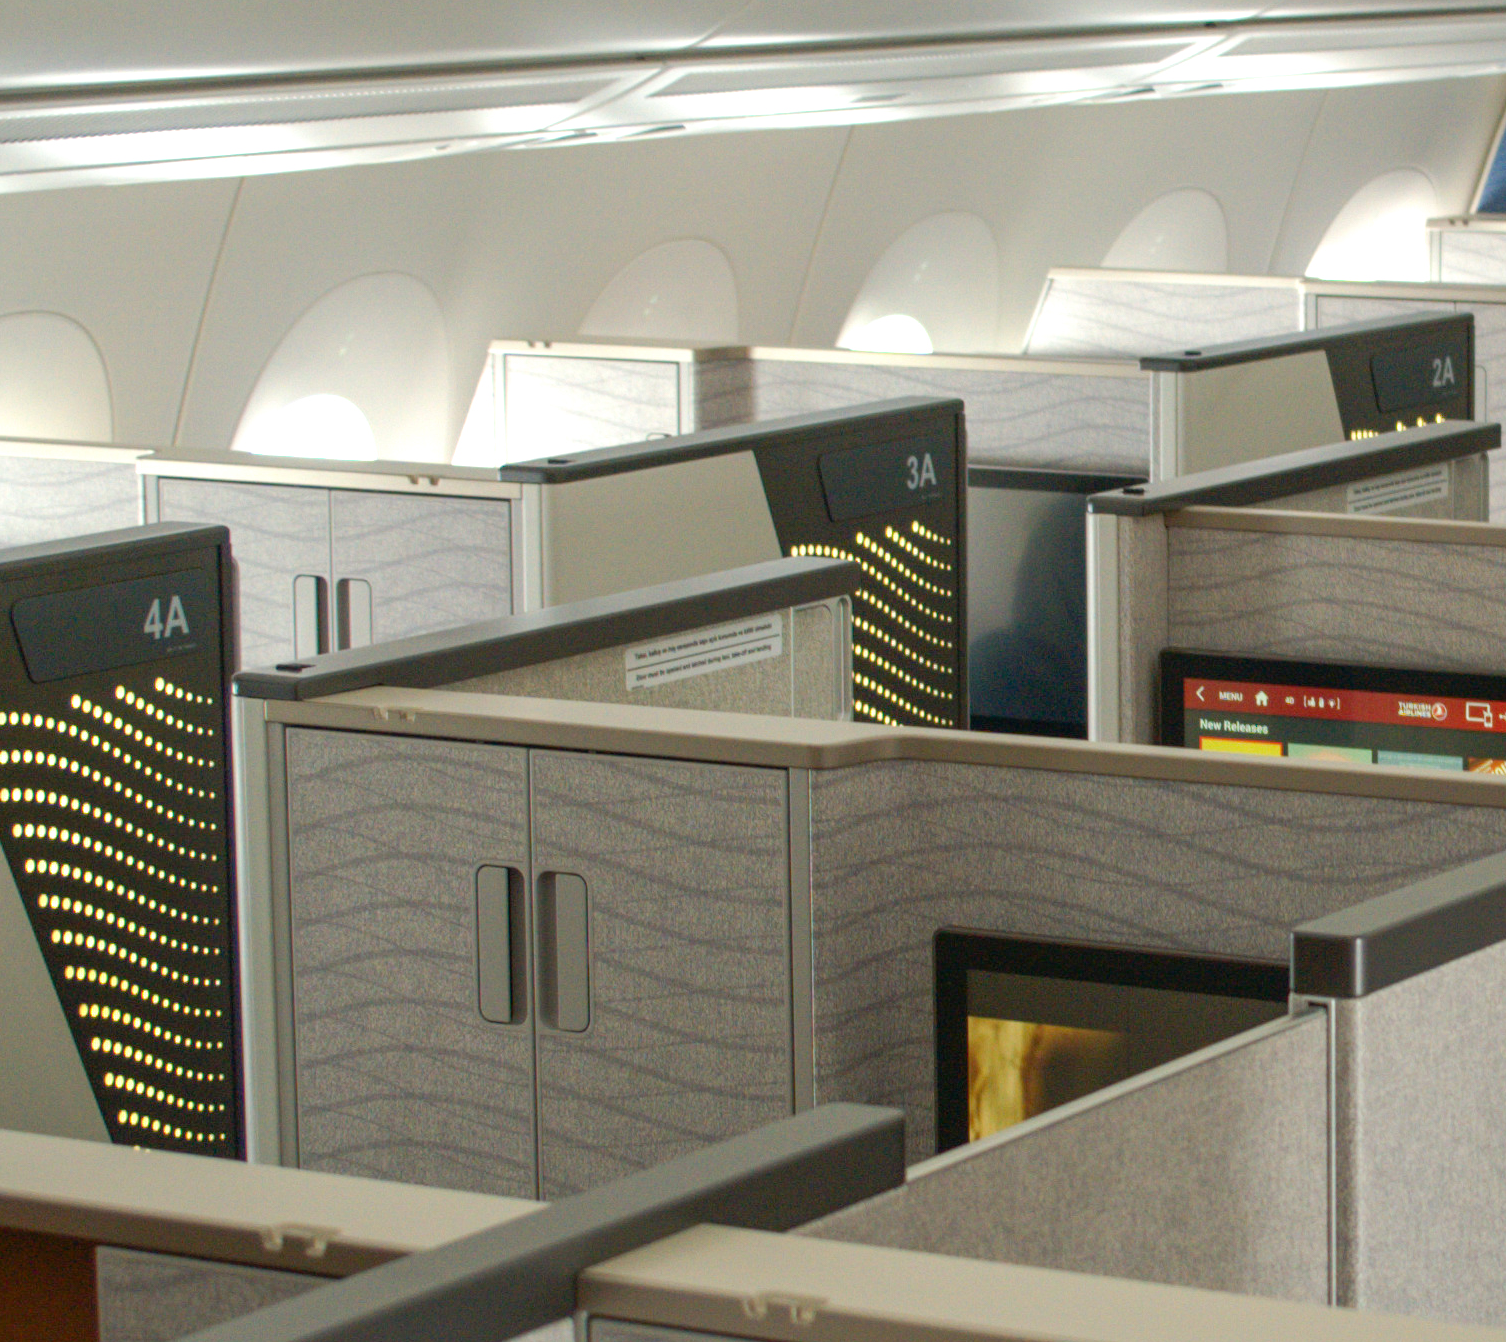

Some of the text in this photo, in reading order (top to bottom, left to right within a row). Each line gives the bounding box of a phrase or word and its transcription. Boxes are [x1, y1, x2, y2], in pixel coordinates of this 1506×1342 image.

[1432, 355, 1455, 388] 2A
[906, 452, 937, 490] 3A
[143, 594, 190, 640] 4A
[1219, 691, 1244, 702] MENU
[1200, 718, 1269, 735] New Releases
